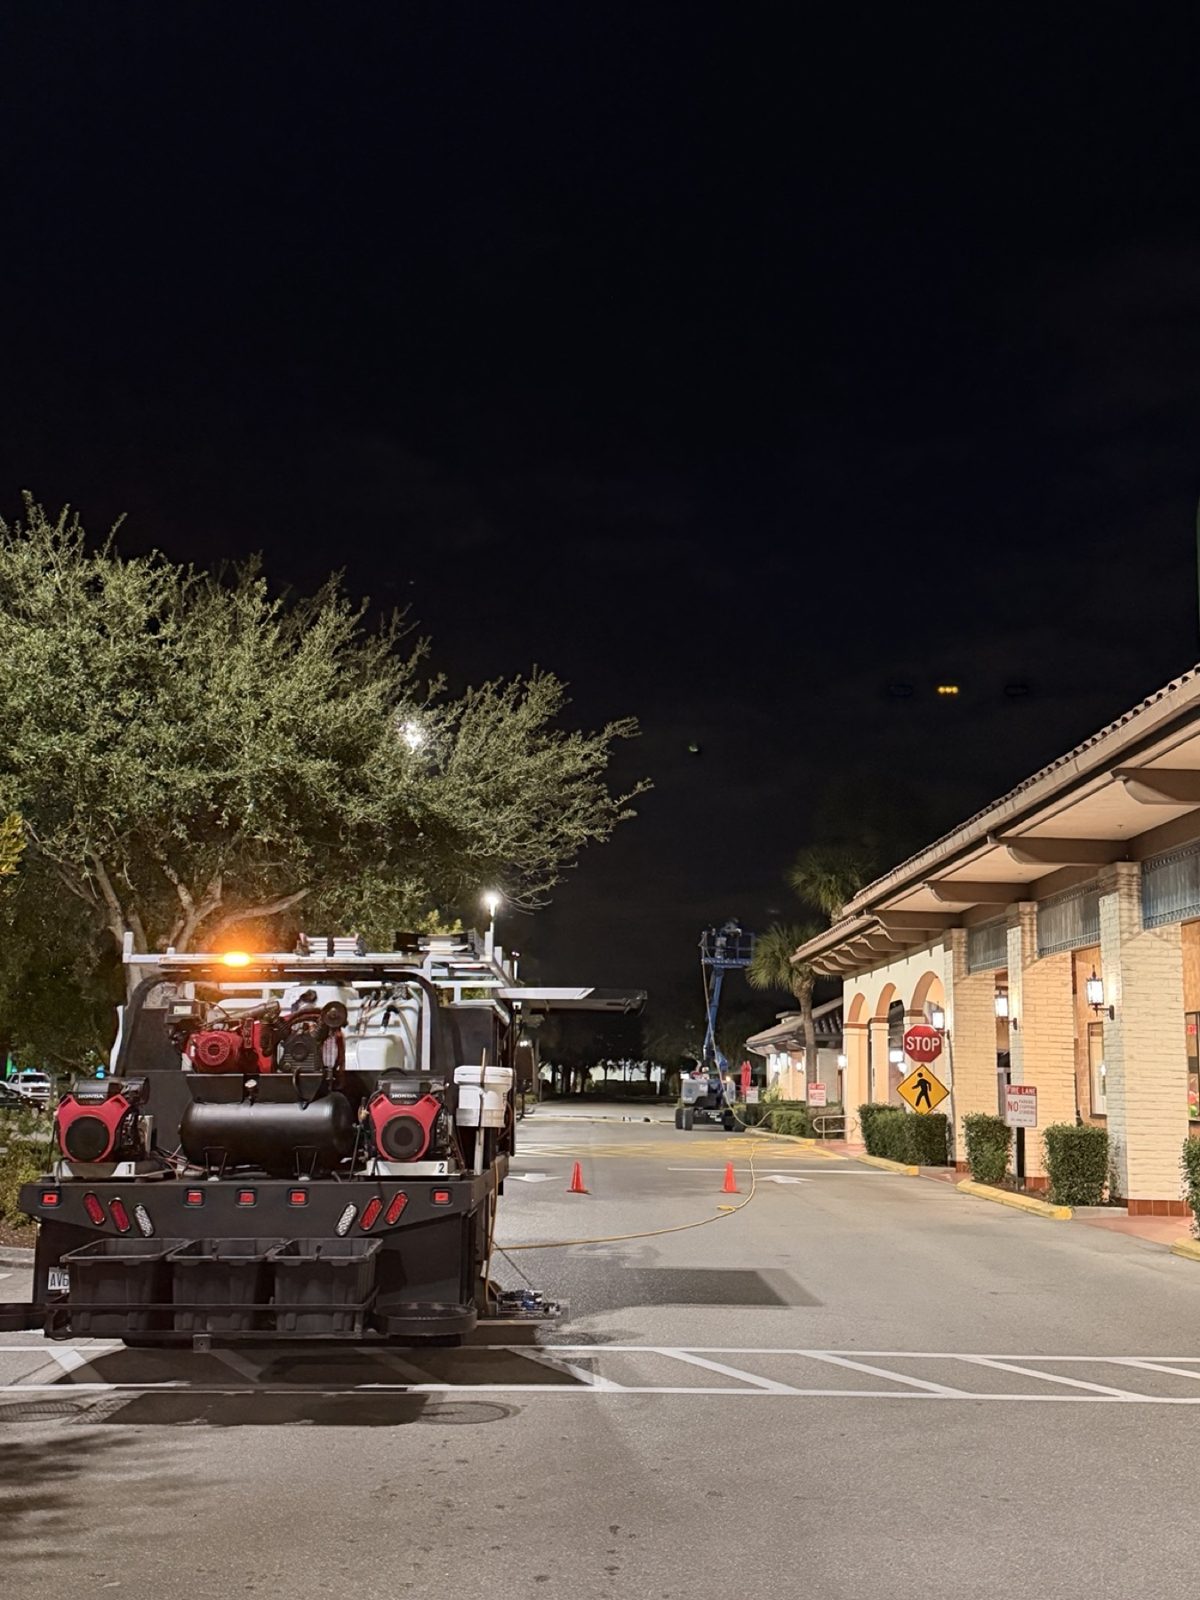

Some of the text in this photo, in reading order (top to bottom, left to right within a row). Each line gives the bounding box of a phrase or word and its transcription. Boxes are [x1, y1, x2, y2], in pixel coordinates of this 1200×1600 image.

[906, 1036, 940, 1052] STOP
[1021, 1087, 1036, 1095] LANE
[1007, 1101, 1019, 1112] NO
[126, 1164, 132, 1173] 1
[438, 1162, 445, 1173] 2
